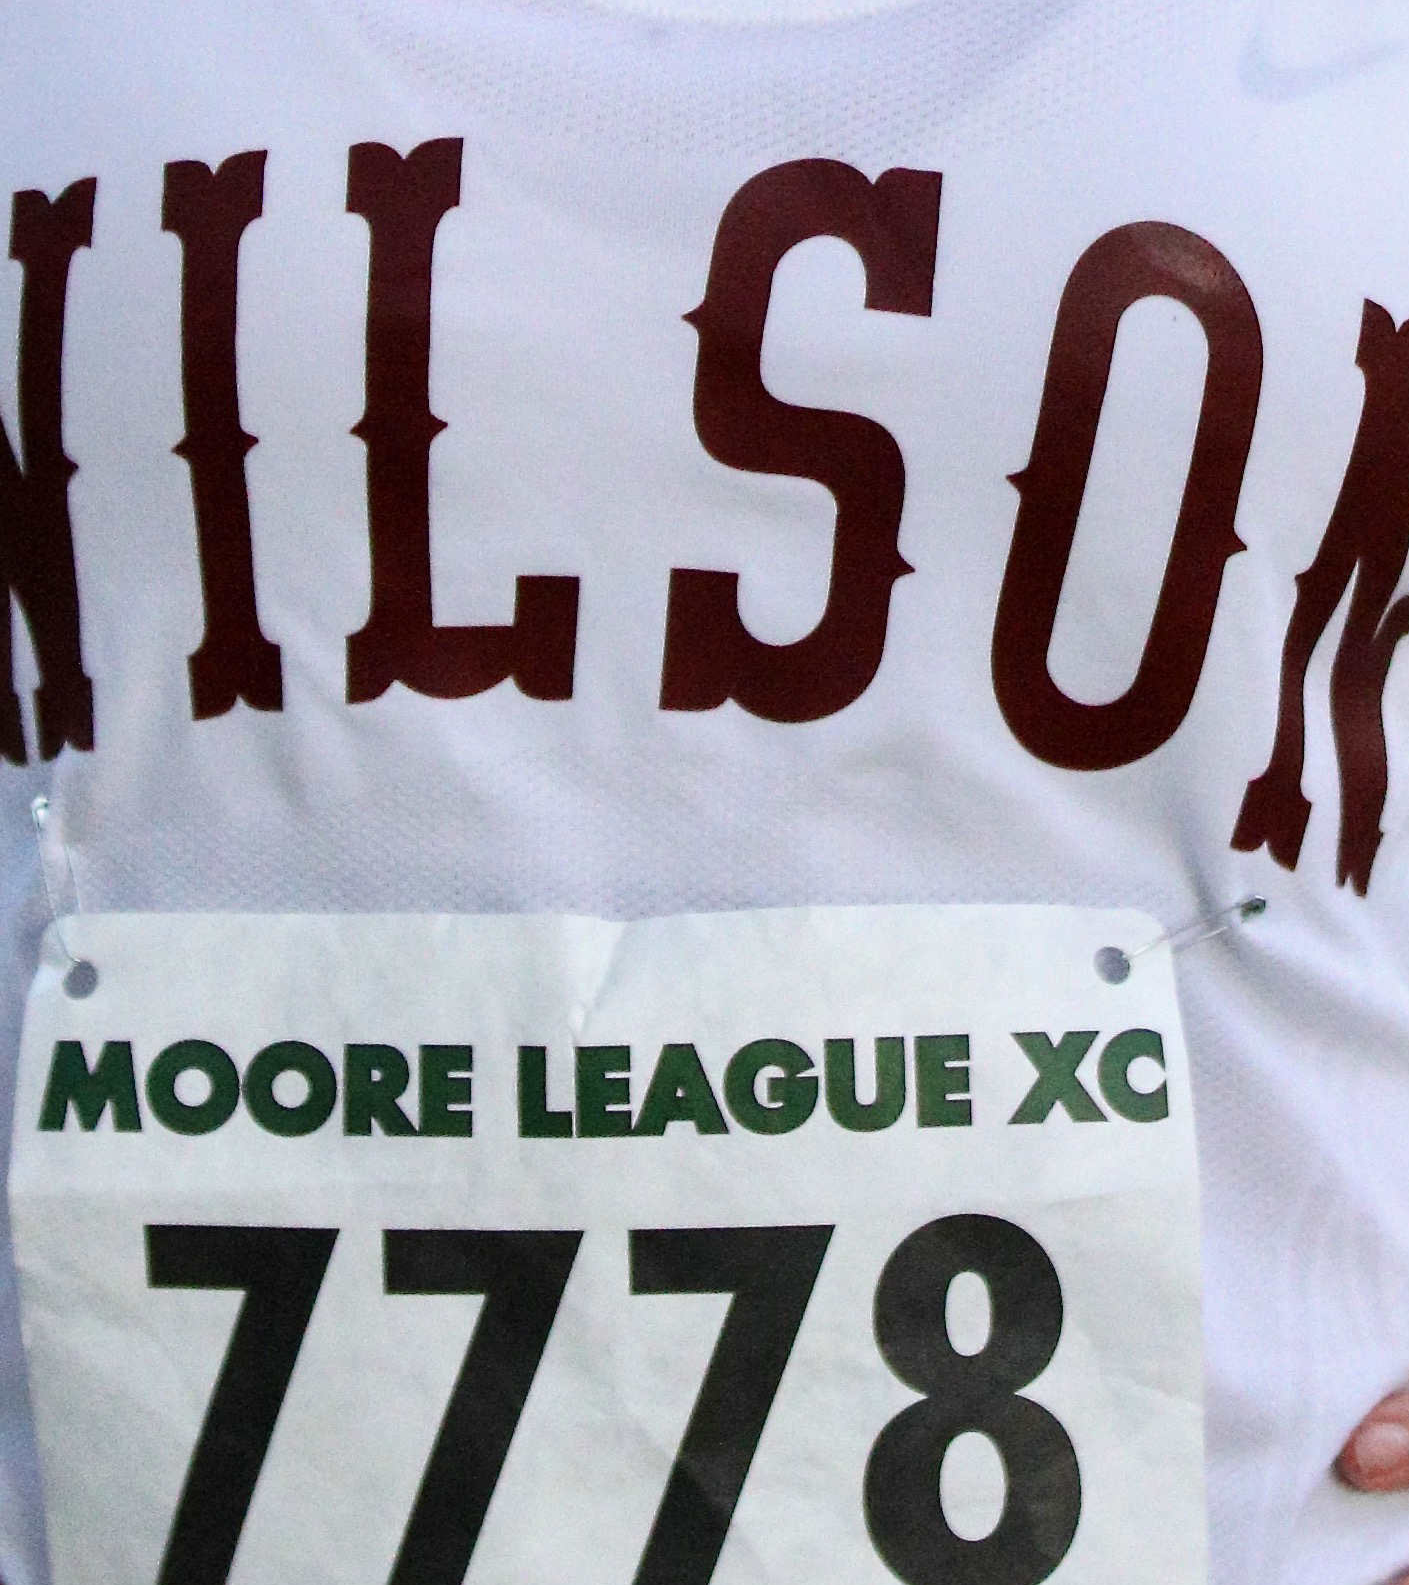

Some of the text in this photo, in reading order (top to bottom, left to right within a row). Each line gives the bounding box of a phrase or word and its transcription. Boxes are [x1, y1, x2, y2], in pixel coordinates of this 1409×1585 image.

[37, 1028, 1169, 1139] MOORE LEAGUE XC
